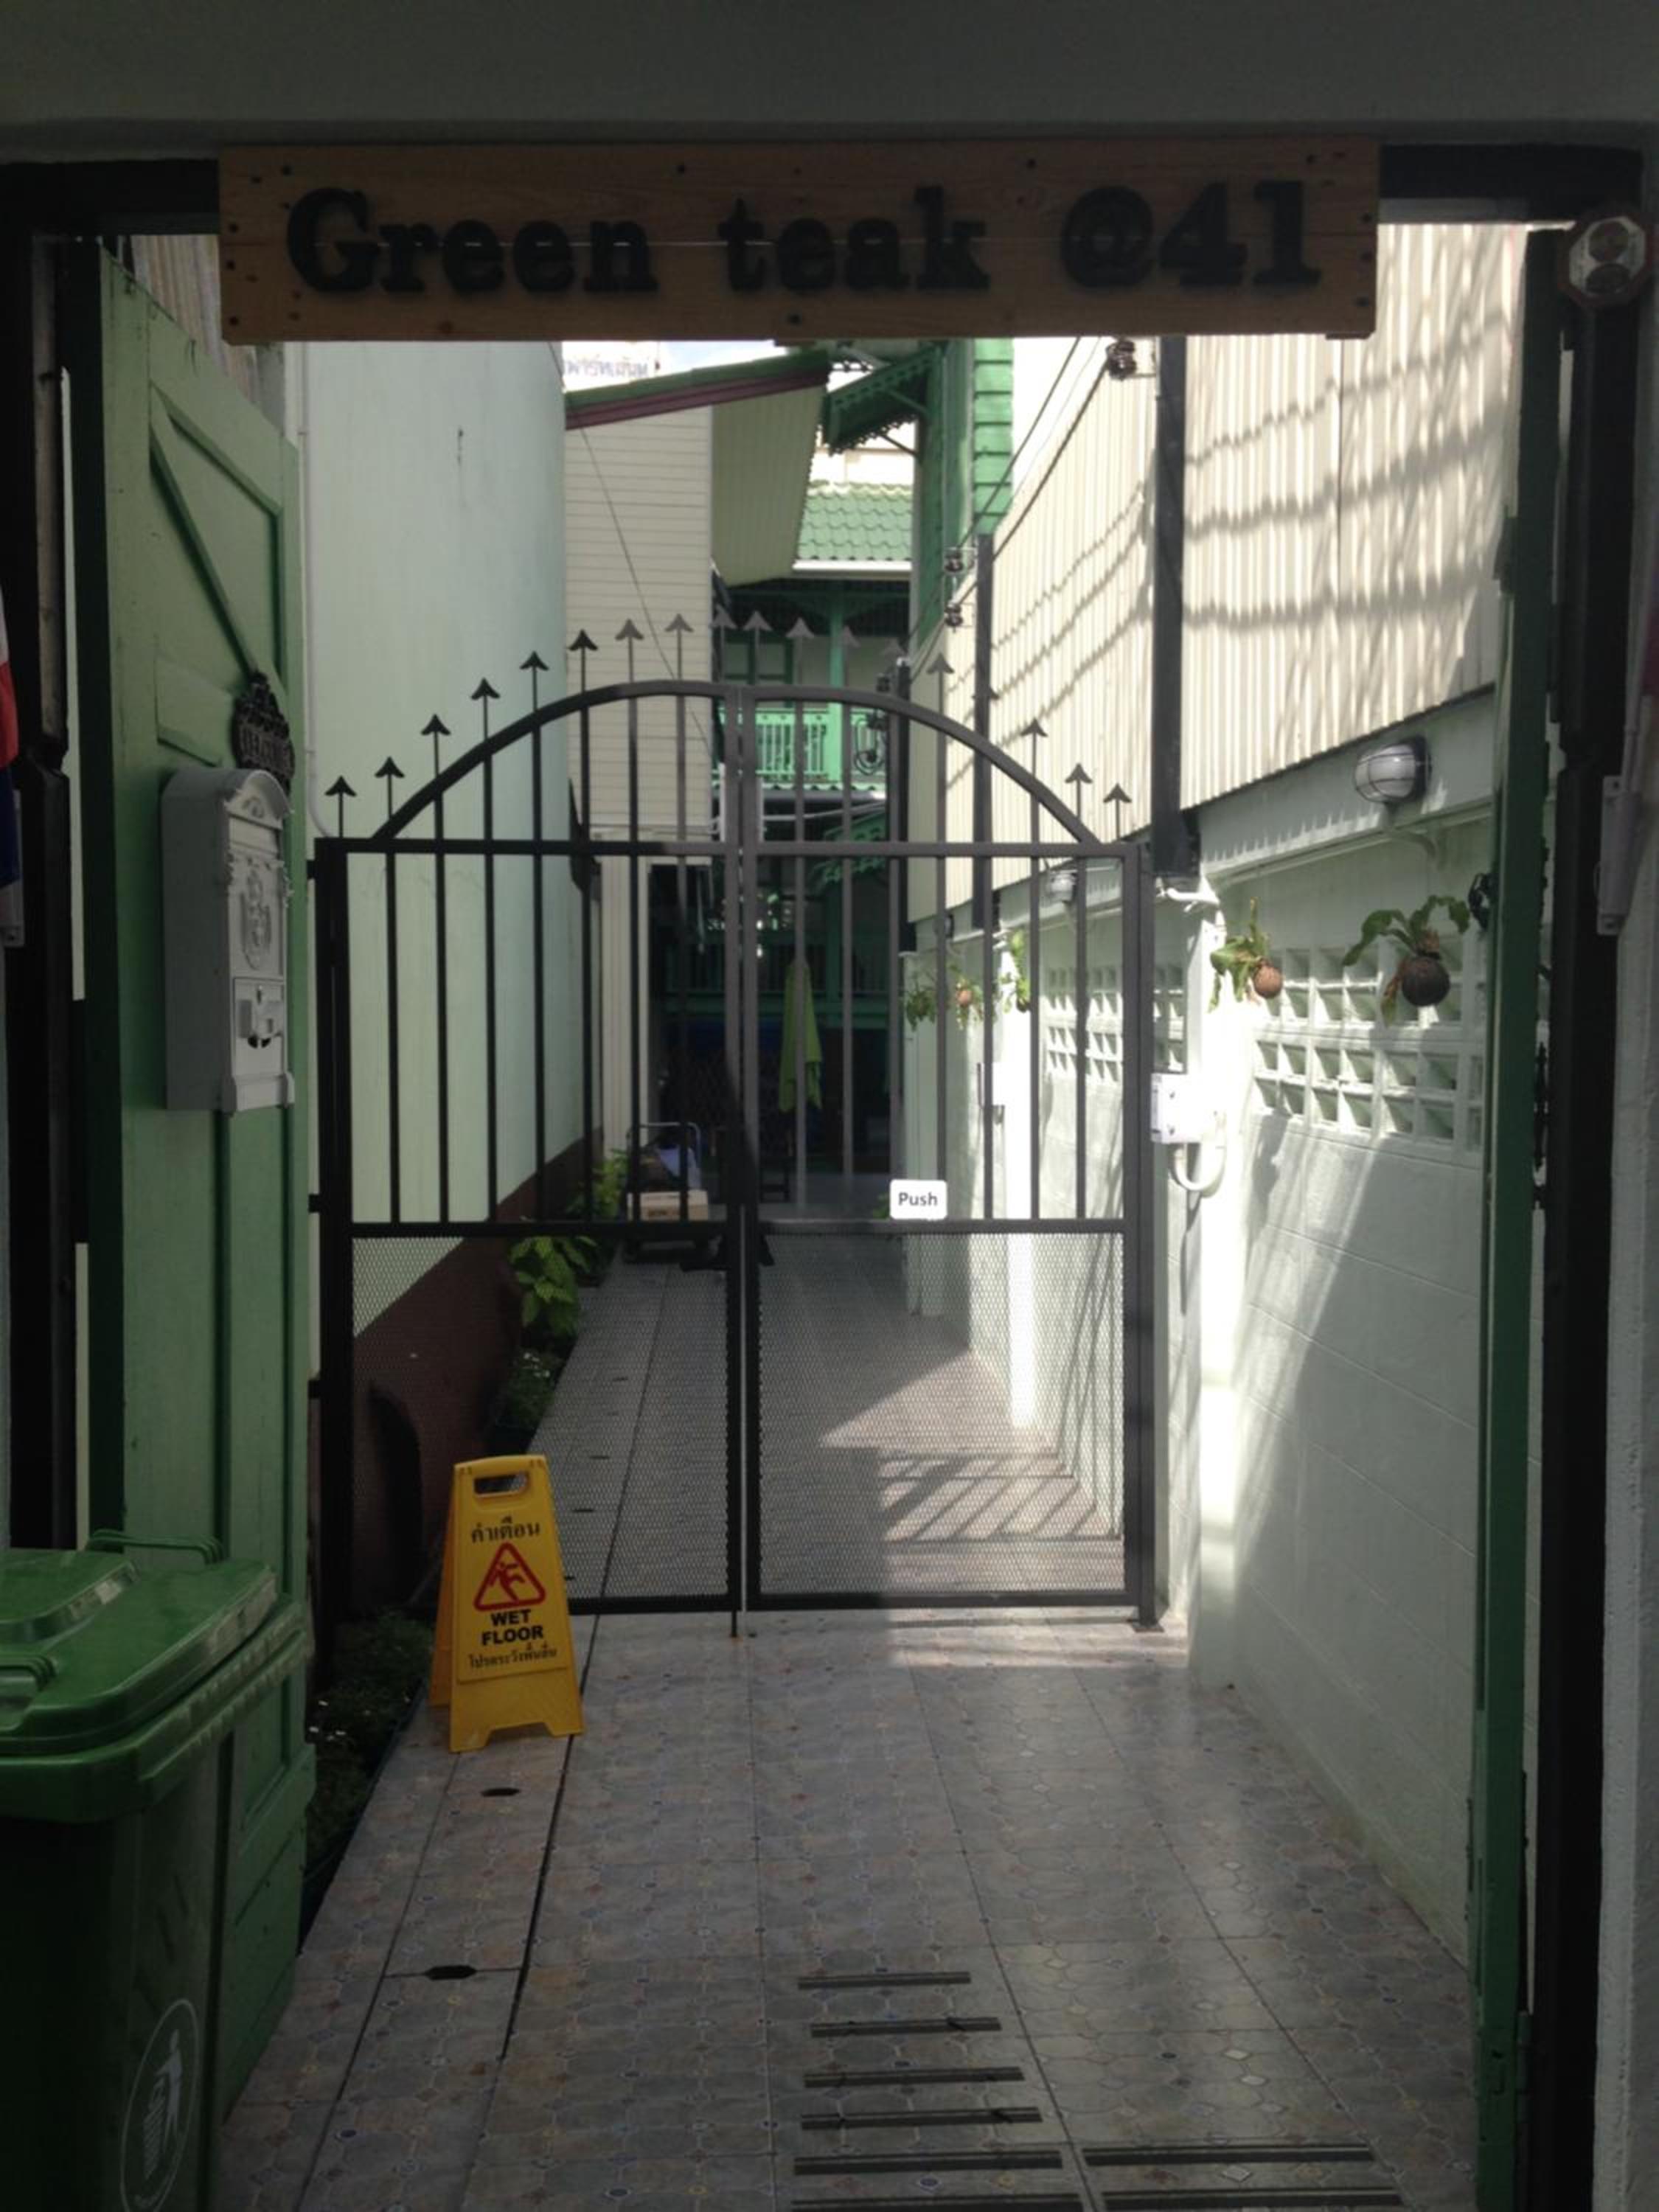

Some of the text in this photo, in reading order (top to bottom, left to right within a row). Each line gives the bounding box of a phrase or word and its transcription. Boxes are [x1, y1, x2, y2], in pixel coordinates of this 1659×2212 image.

[287, 179, 1322, 293] Green teak @41
[898, 1192, 938, 1206] Push
[471, 1515, 540, 1543] คำเตือน
[490, 1610, 532, 1627] WET
[481, 1625, 543, 1646] FLOOR
